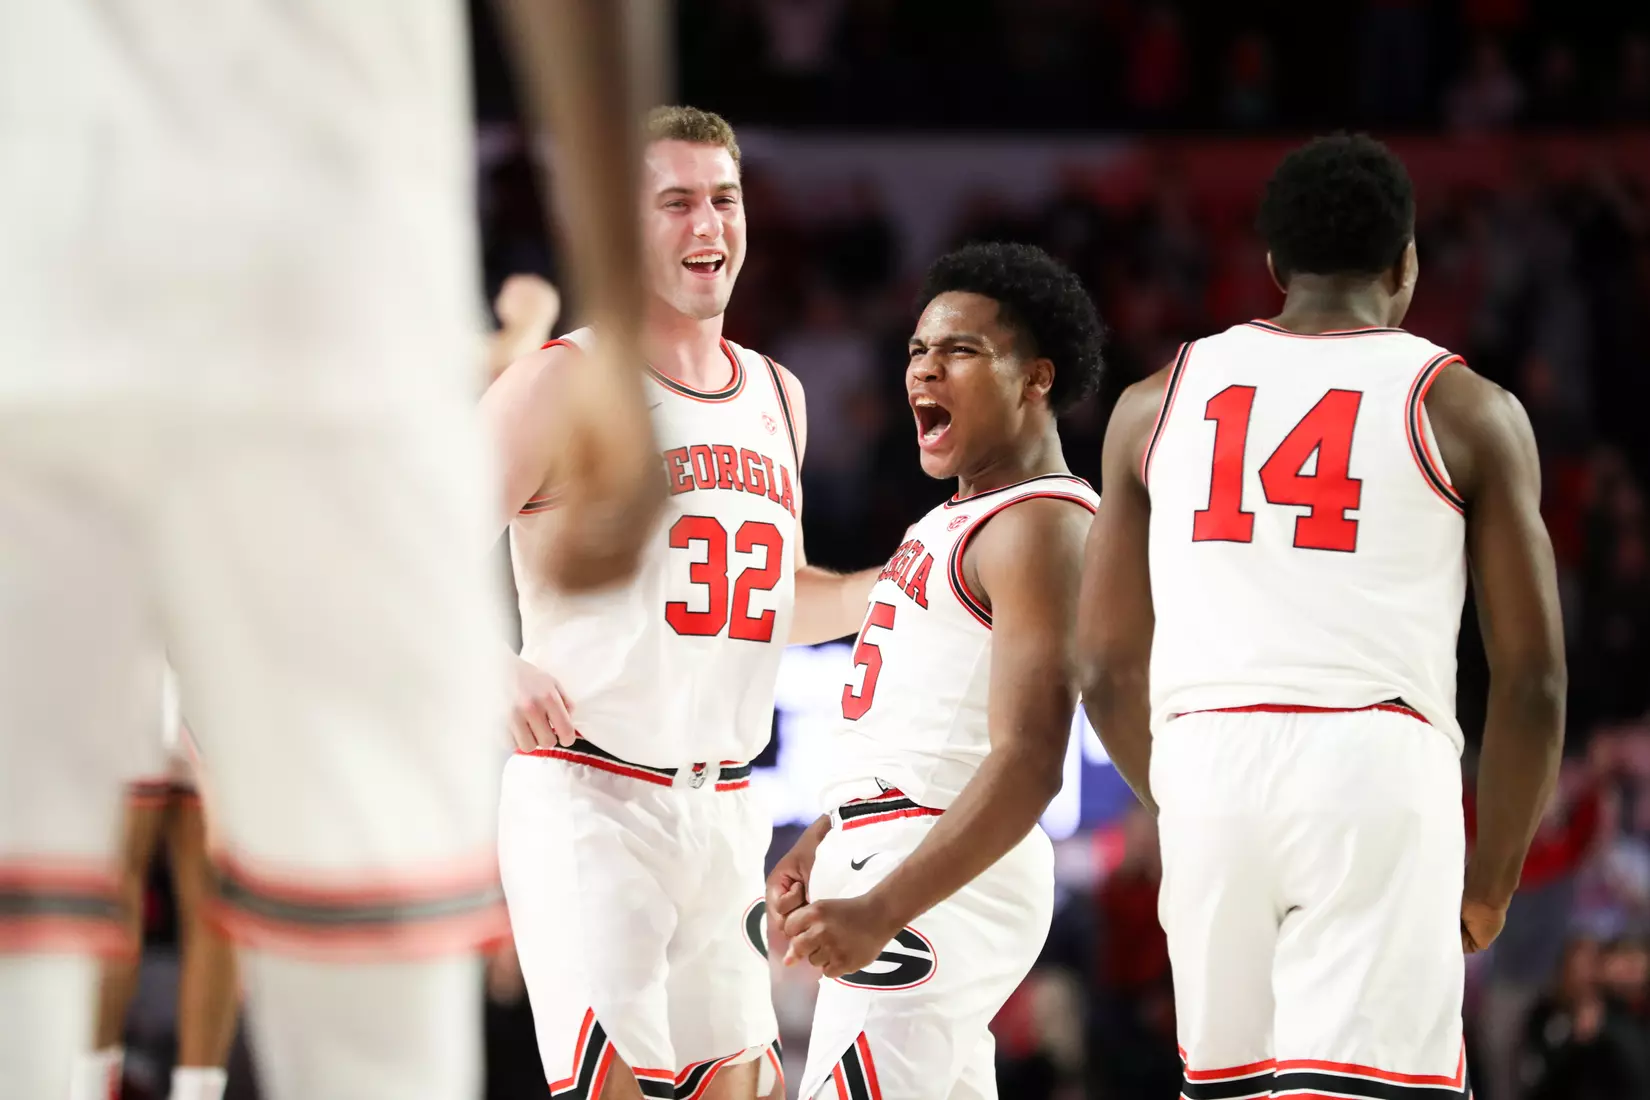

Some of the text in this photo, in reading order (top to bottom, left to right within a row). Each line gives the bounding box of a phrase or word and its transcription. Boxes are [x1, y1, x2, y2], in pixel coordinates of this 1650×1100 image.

[663, 444, 796, 519] EORGIA
[1192, 384, 1364, 553] 14
[665, 515, 784, 643] 32
[841, 601, 896, 721] 5
